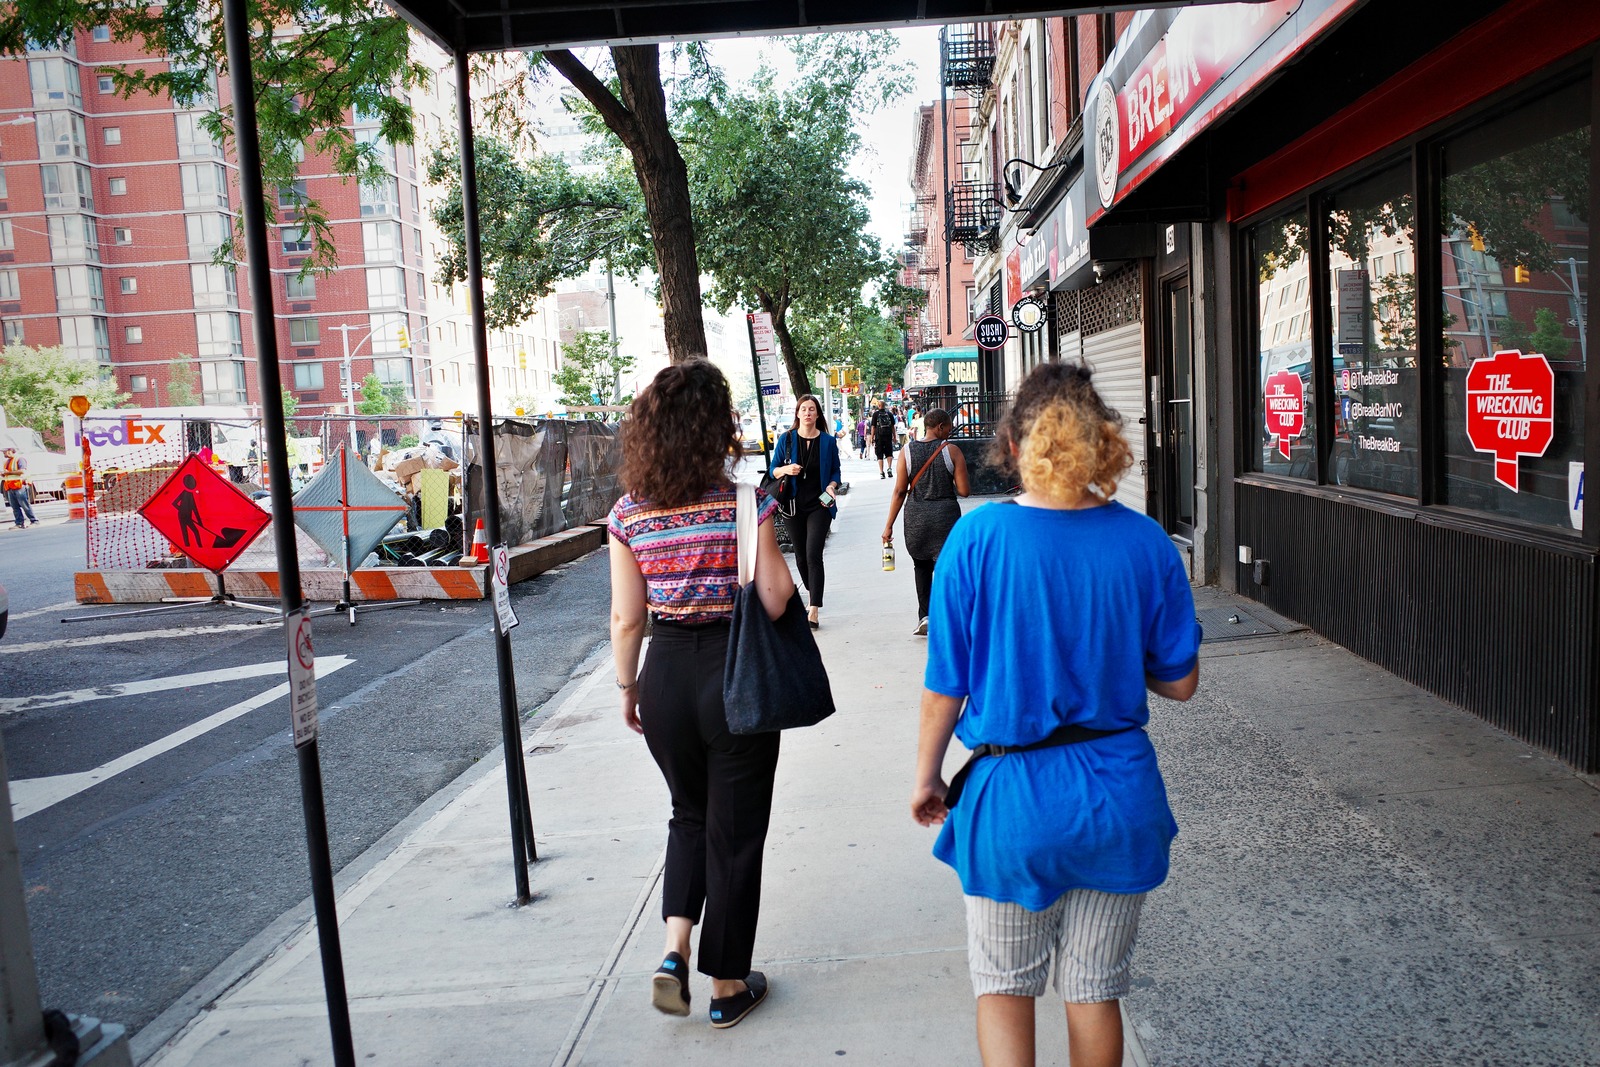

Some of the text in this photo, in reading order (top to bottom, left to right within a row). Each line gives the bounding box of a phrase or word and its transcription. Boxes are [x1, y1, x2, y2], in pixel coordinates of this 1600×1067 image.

[980, 323, 1003, 337] SUSHI
[948, 361, 978, 383] SUGAR
[1351, 370, 1399, 389] @TheBreakBar
[1274, 385, 1287, 396] THE
[1486, 373, 1513, 392] THE
[1269, 398, 1300, 410] WRECKING
[1351, 402, 1403, 420] @BreakBarNYC
[1476, 395, 1544, 416] WRECKING
[1279, 413, 1294, 427] CLUB
[1497, 420, 1531, 441] CLUB
[1358, 435, 1401, 453] TheBreakBar
